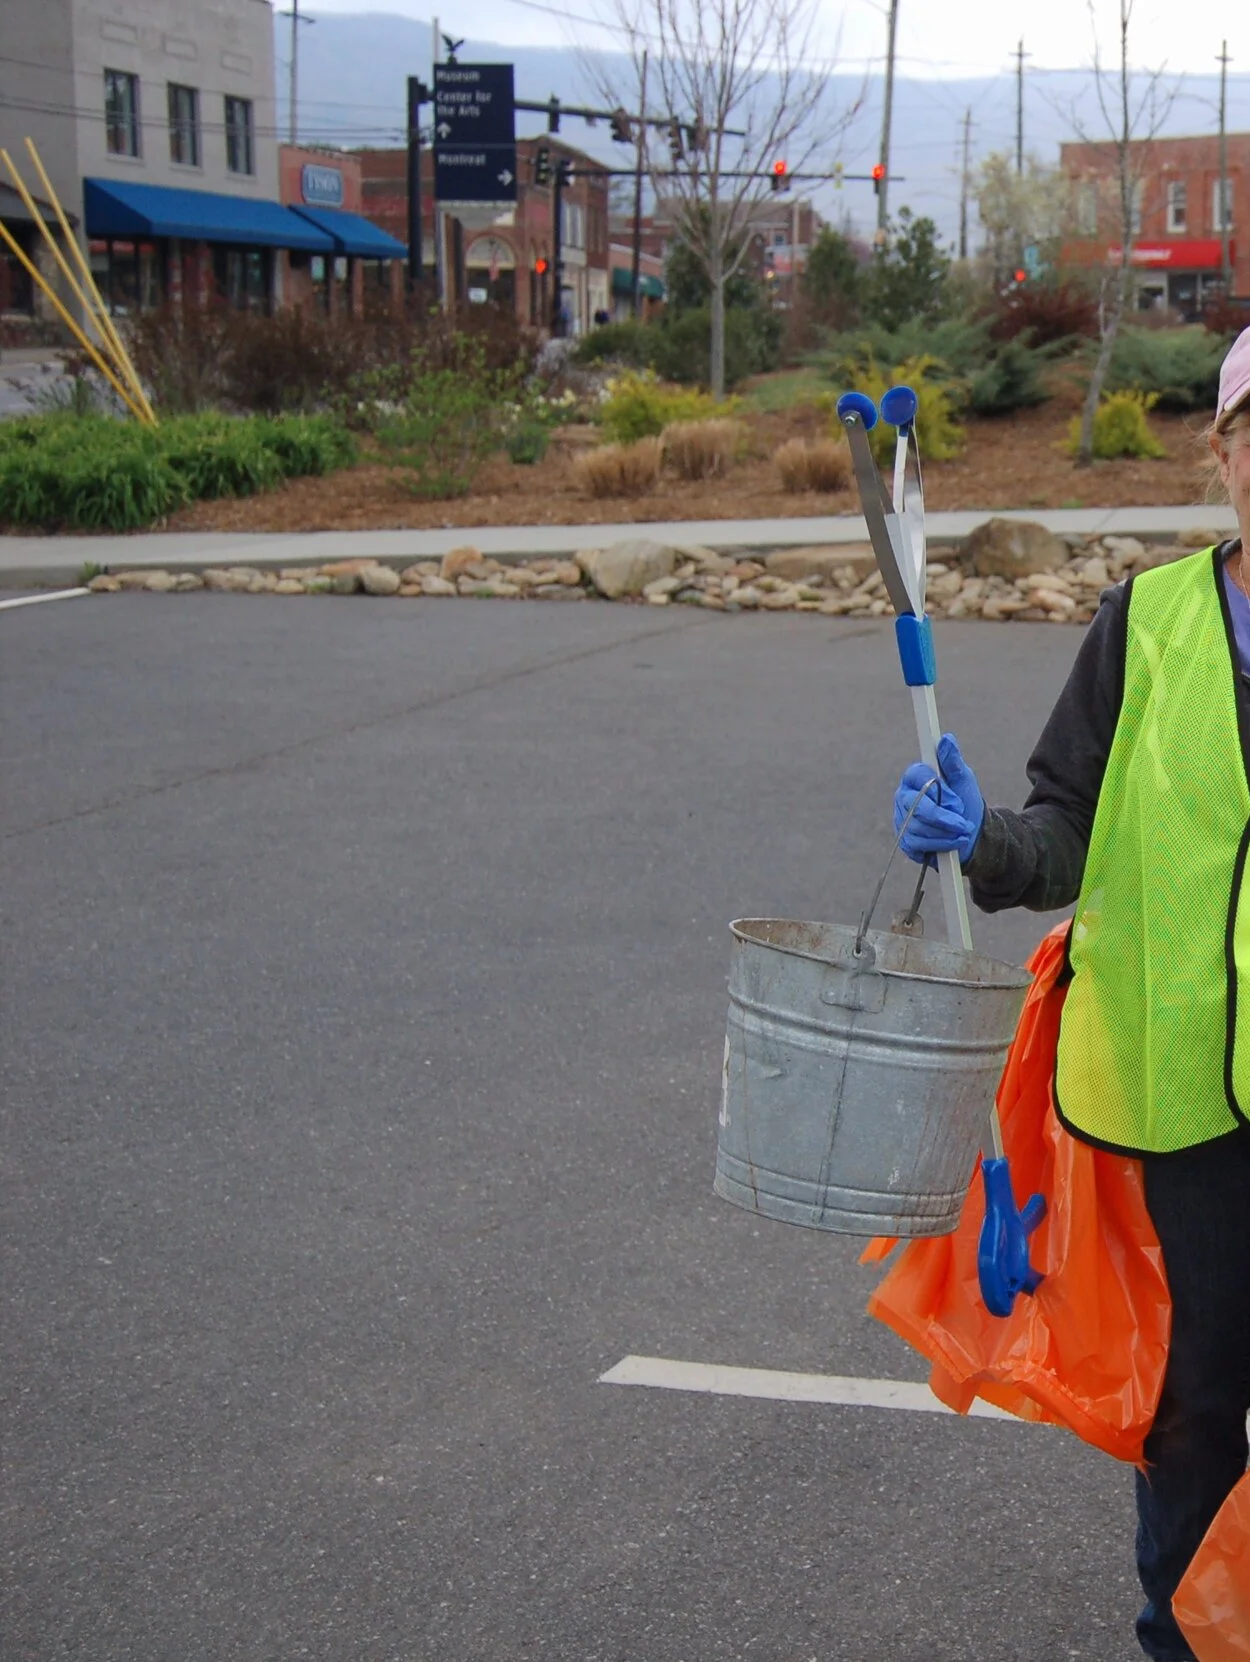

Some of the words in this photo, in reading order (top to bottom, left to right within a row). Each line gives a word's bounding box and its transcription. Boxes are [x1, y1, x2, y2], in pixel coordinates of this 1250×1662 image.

[436, 70, 480, 82] Museum
[437, 91, 472, 103] Center
[475, 90, 492, 103] for
[437, 105, 455, 117] the
[458, 105, 480, 117] Arts
